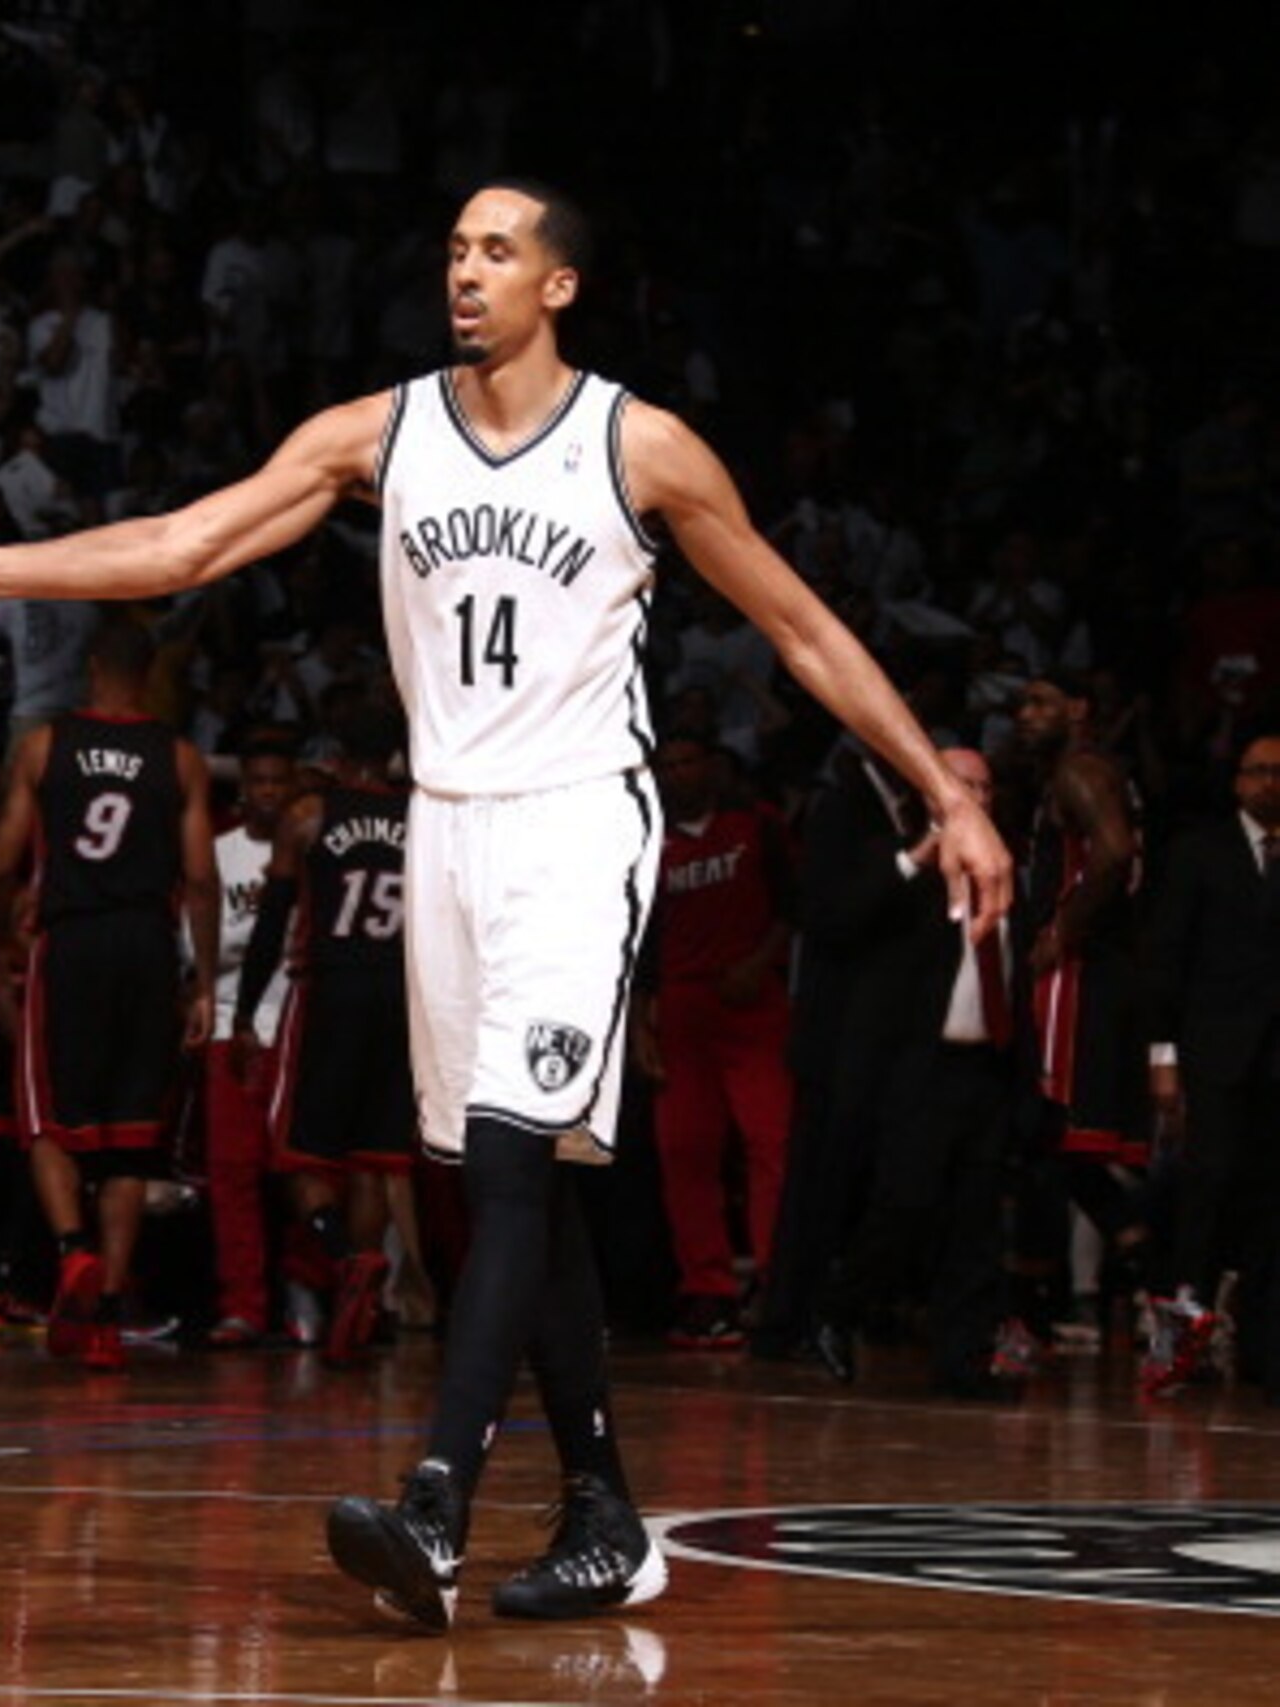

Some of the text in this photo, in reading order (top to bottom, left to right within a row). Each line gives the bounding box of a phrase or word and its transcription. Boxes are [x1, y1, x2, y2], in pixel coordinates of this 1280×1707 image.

[399, 503, 597, 588] BROOKLYN
[454, 594, 519, 690] 14
[75, 748, 144, 782] LEWIS
[74, 790, 134, 862] 9
[331, 868, 404, 940] 15
[666, 843, 749, 896] HEAT
